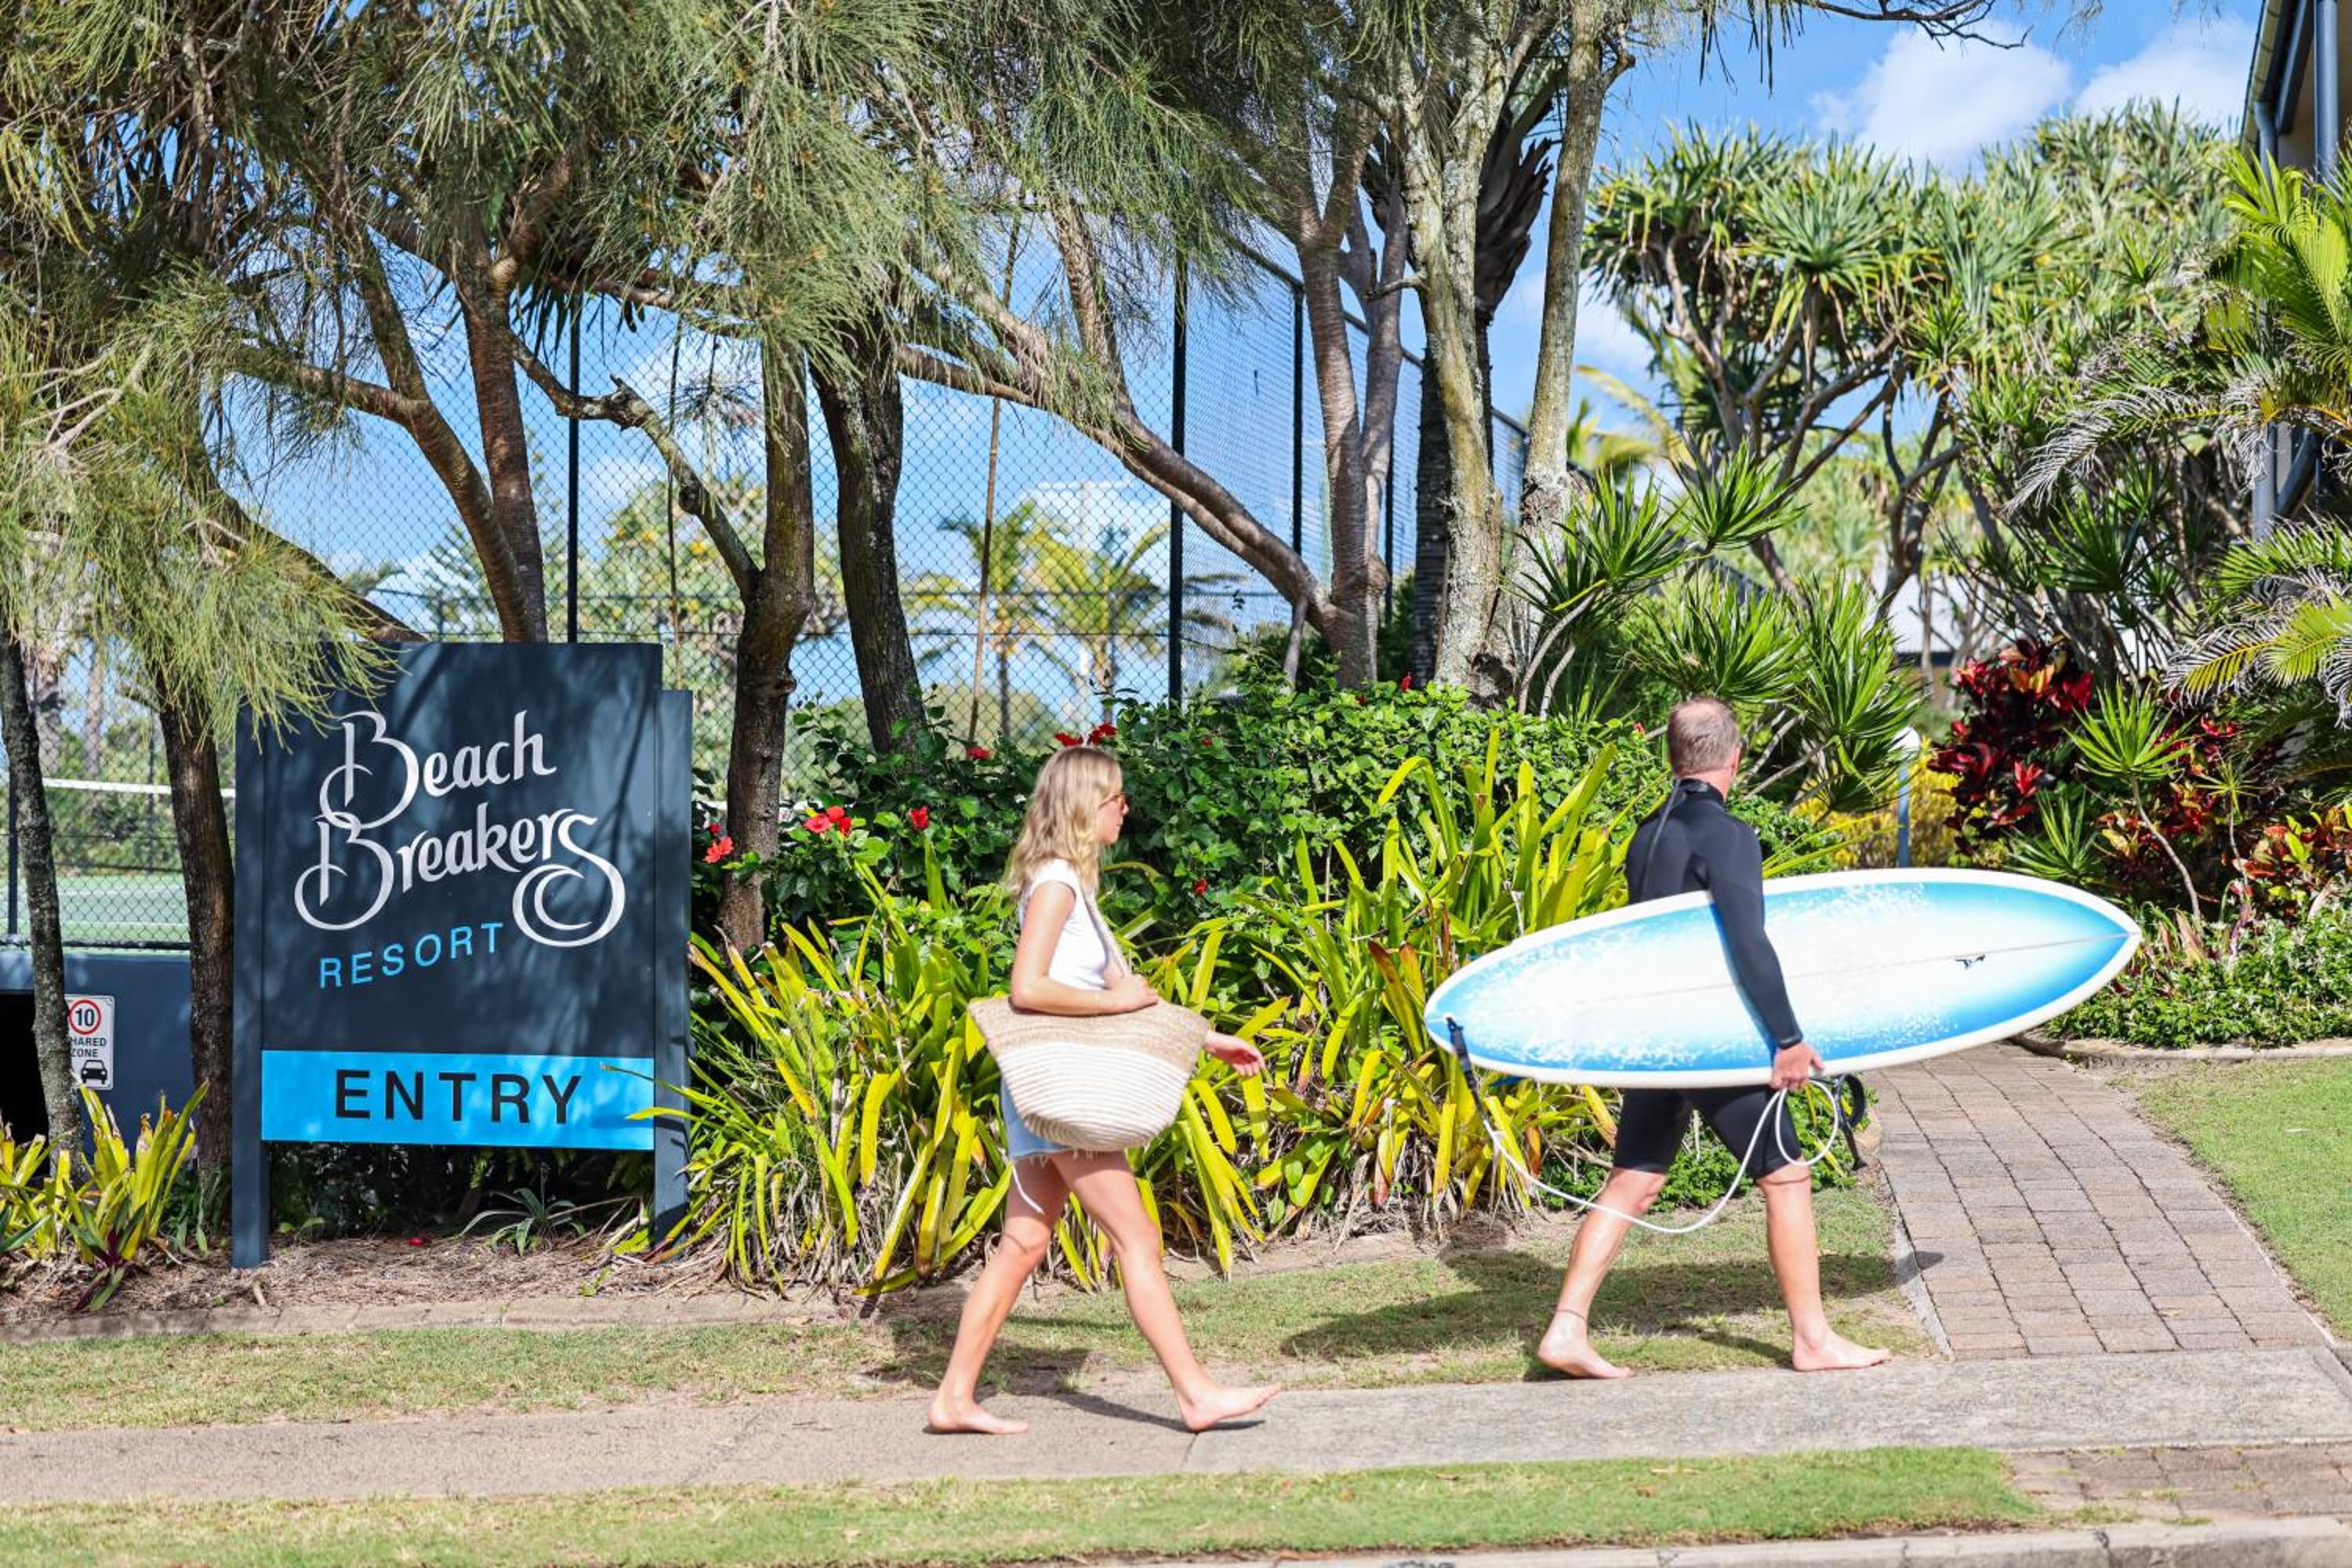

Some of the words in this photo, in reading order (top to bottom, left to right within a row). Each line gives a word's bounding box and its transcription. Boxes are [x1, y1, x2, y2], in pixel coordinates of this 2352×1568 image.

[318, 710, 557, 830] Beach
[294, 802, 626, 948] Breakers
[320, 923, 503, 988] RESORT
[71, 1037, 107, 1047] HARED
[75, 1008, 94, 1026] 10
[71, 1048, 99, 1058] ZONE
[334, 1069, 582, 1124] ENTRY
